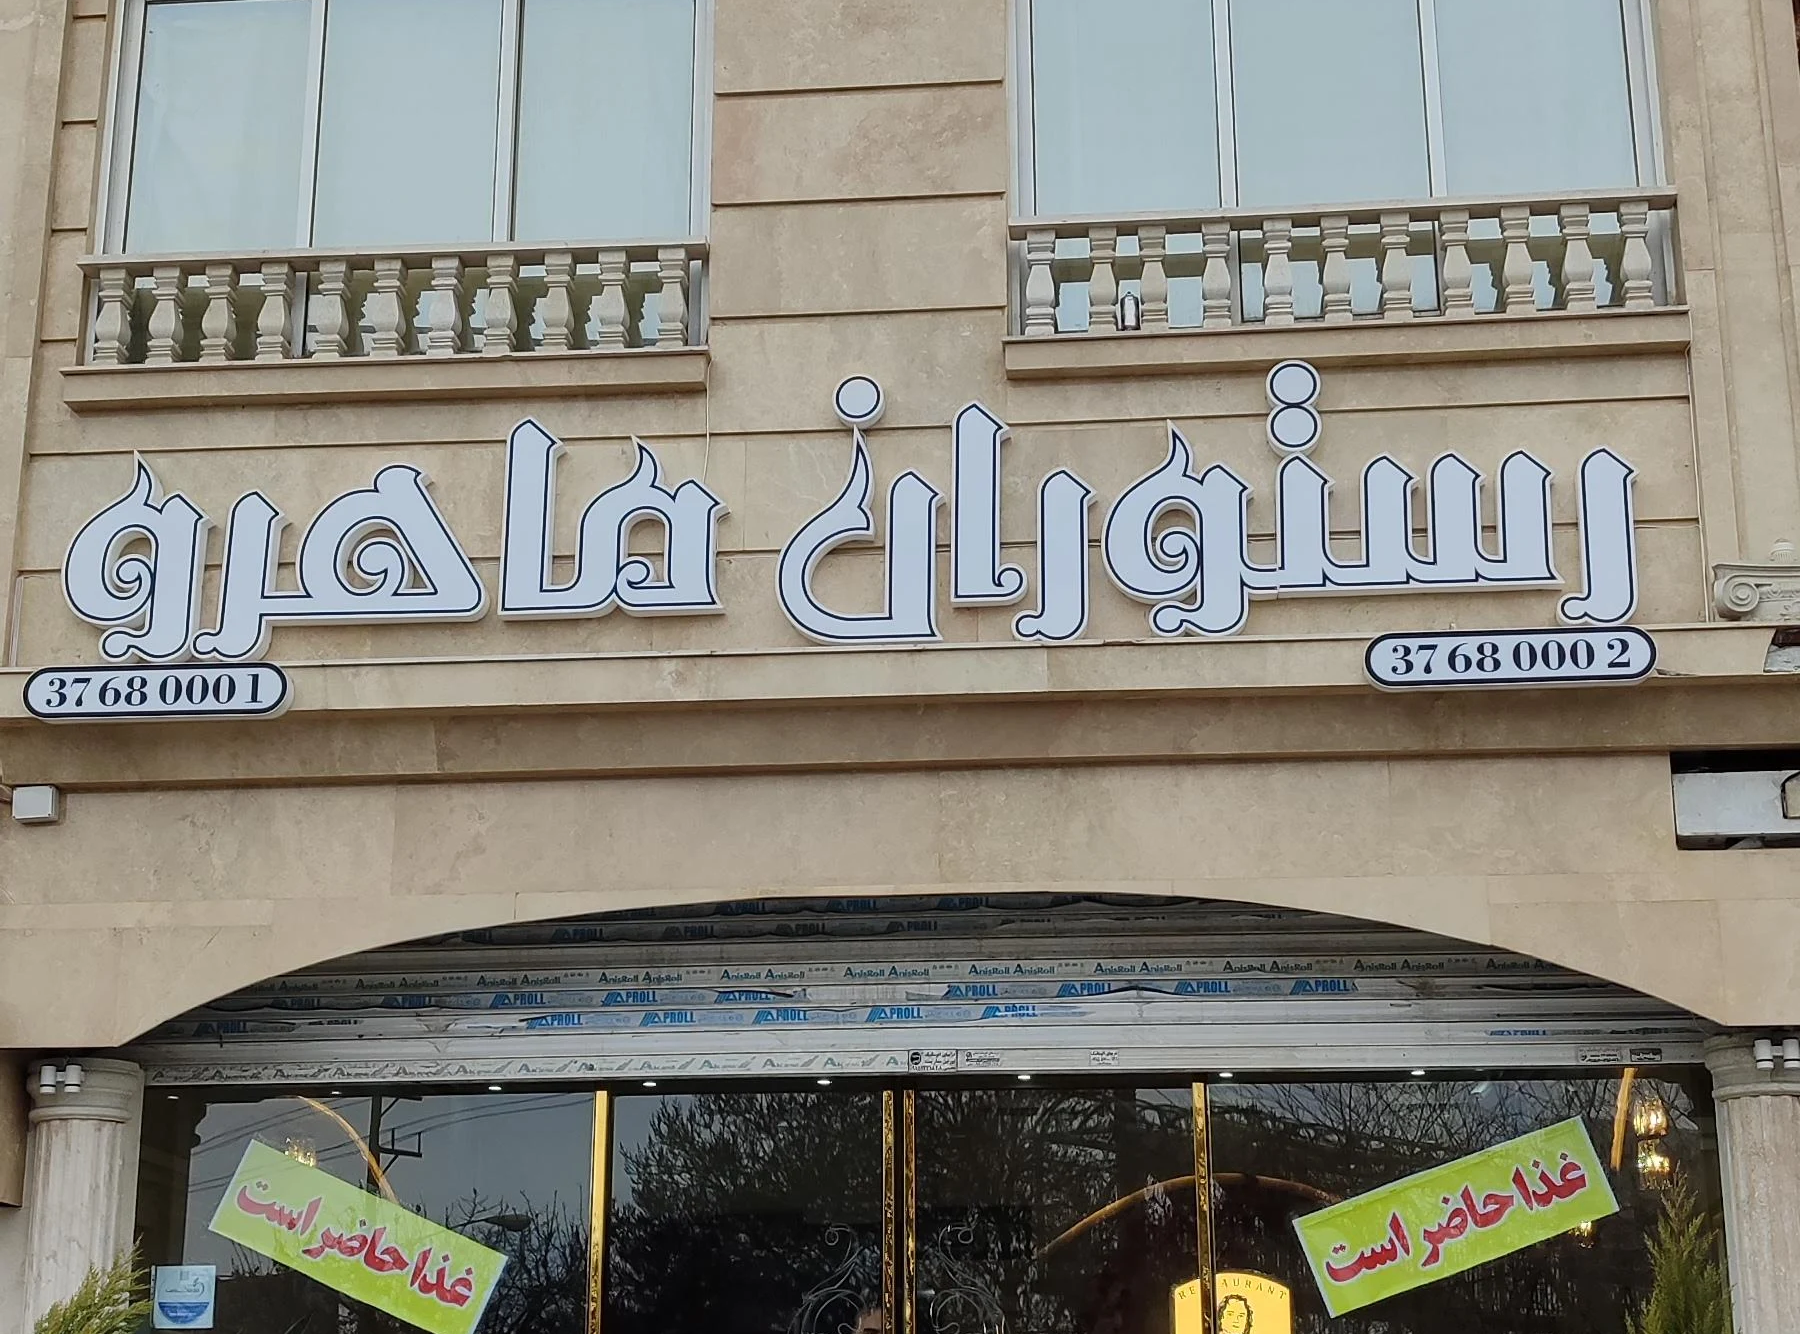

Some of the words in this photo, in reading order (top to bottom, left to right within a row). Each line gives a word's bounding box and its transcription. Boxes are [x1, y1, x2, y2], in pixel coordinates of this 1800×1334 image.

[777, 358, 1639, 646] رستوران
[63, 416, 729, 663] ماهرو
[236, 1178, 323, 1237] است
[1512, 1151, 1589, 1212] غذا
[303, 1217, 410, 1275] حاضر
[1325, 1211, 1412, 1284] است
[1420, 1183, 1515, 1268] حاضر
[409, 1245, 476, 1309] غذا
[1178, 1278, 1288, 1300] REAURANT
